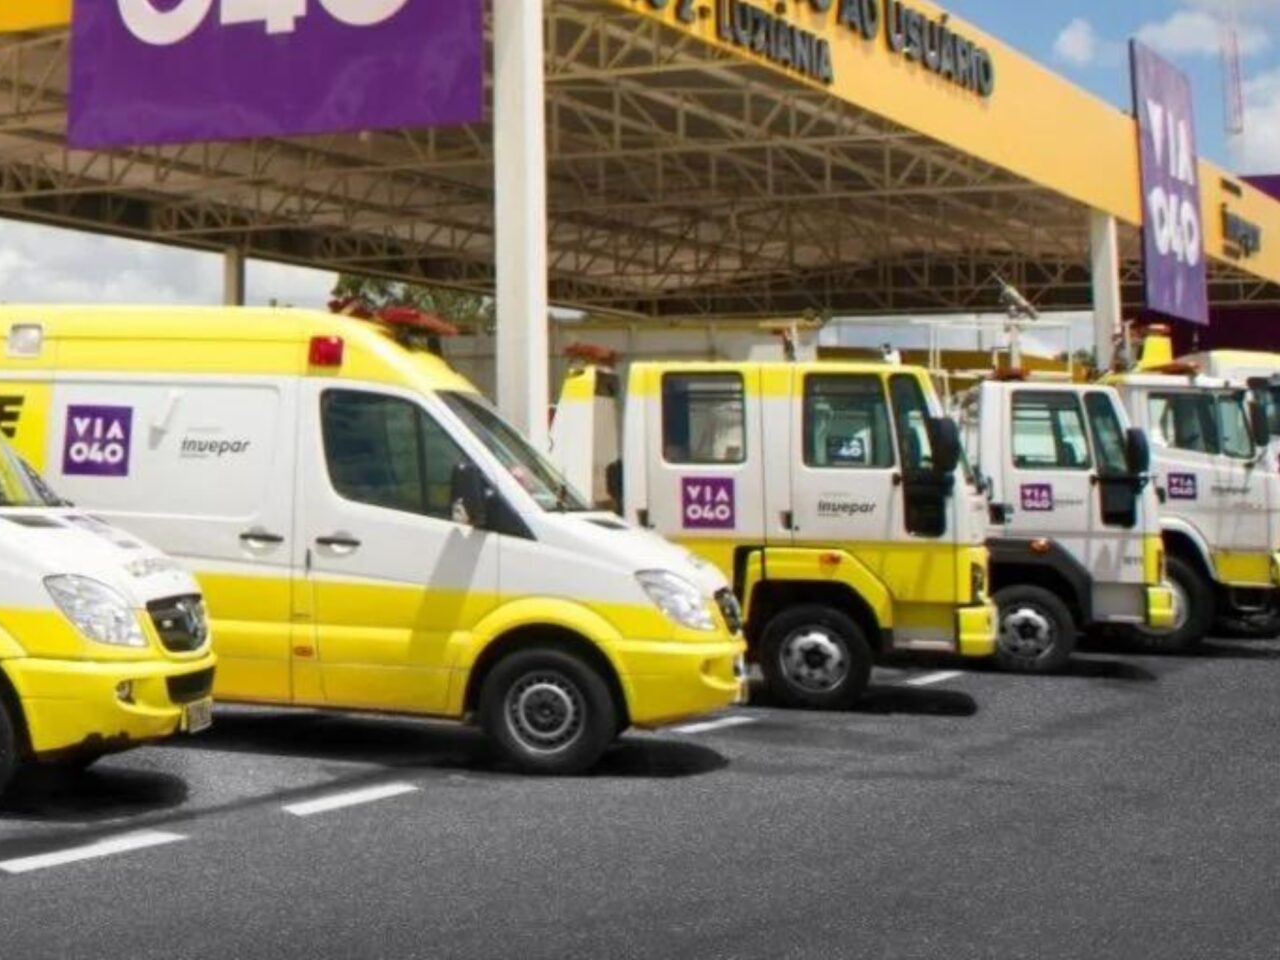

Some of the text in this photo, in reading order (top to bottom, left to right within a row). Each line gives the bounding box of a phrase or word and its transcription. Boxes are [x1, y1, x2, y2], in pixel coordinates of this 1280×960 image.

[1146, 99, 1195, 186] VIA
[1148, 186, 1201, 268] 040
[73, 417, 125, 440] VIA
[69, 441, 124, 464] 040
[179, 436, 252, 456] invepar
[686, 486, 730, 503] VIA
[686, 504, 731, 520] 040
